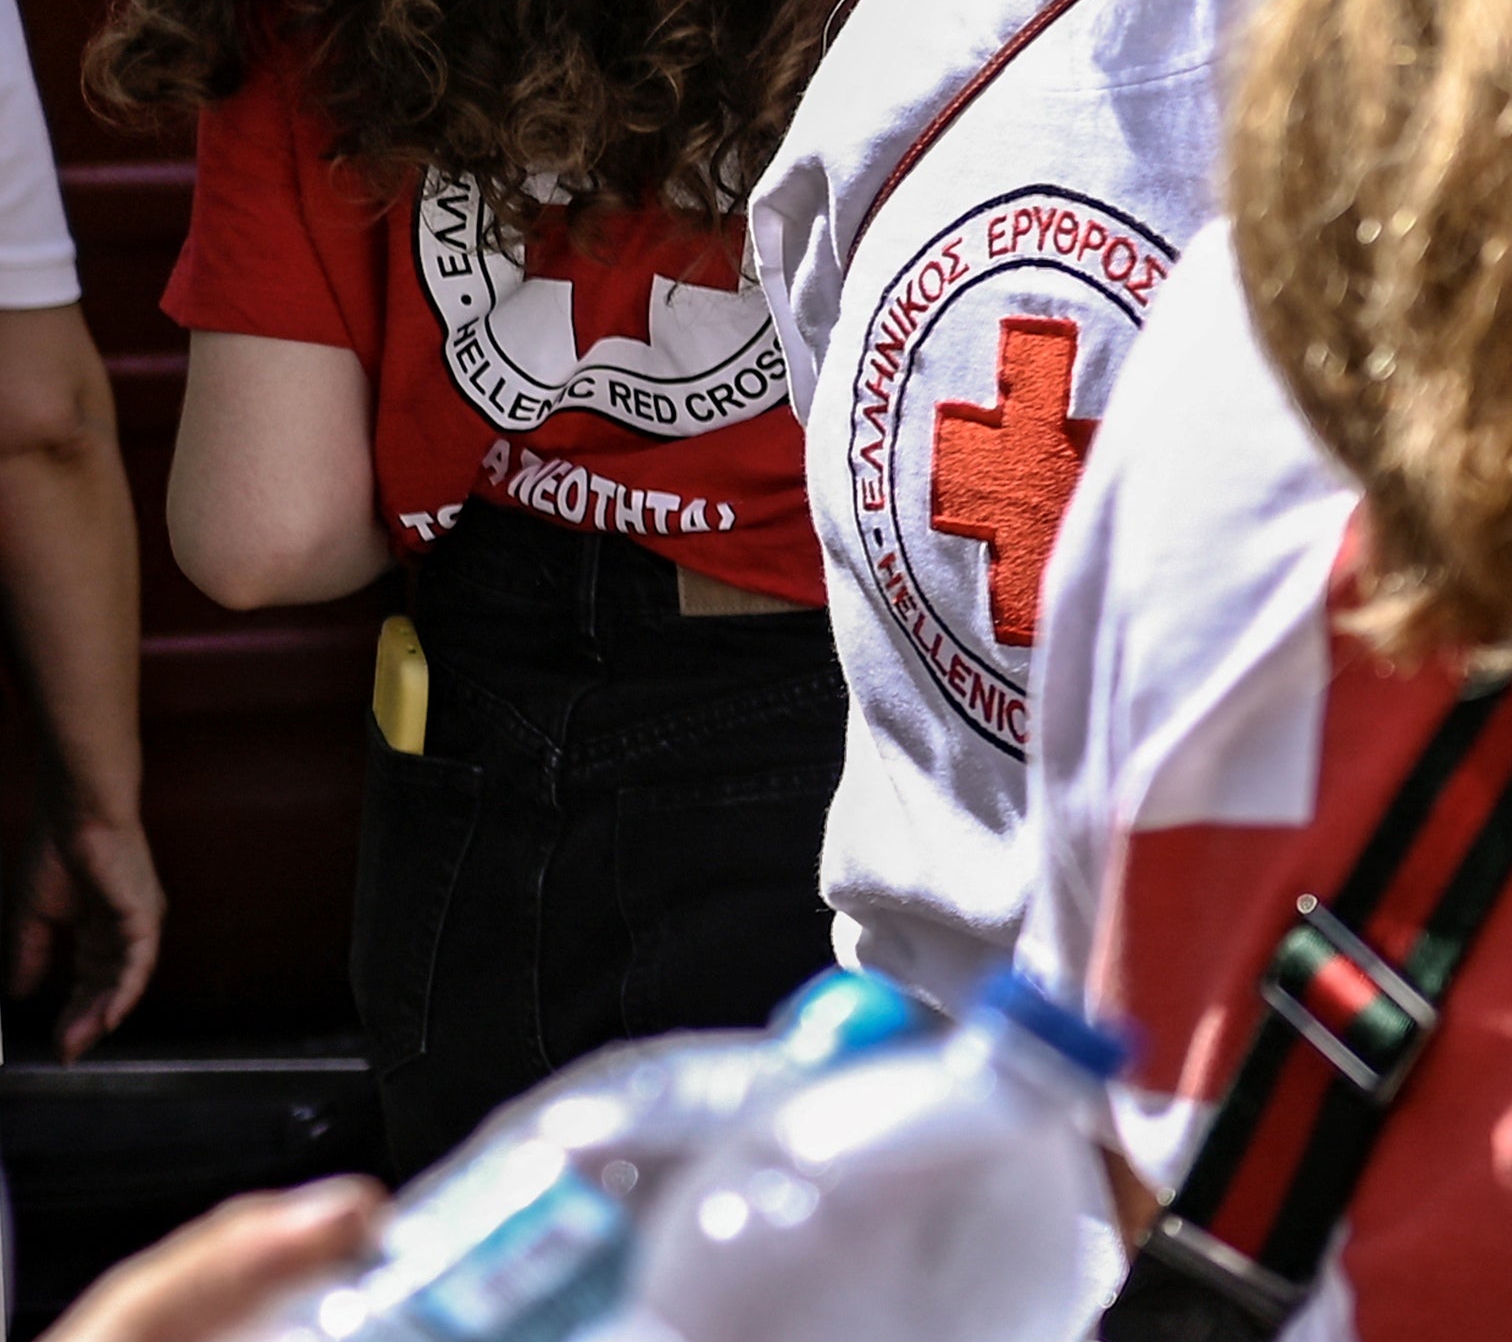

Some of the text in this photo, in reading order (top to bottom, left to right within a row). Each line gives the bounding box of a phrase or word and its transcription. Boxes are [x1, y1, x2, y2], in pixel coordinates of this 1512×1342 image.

[608, 379, 678, 426] RED
[685, 335, 787, 424] CROS
[860, 206, 1168, 511] ΕΛΛΗΝΙΚΟΣ ΕΡΥΘΡΟΣ
[876, 551, 1030, 745] HELLENIC
